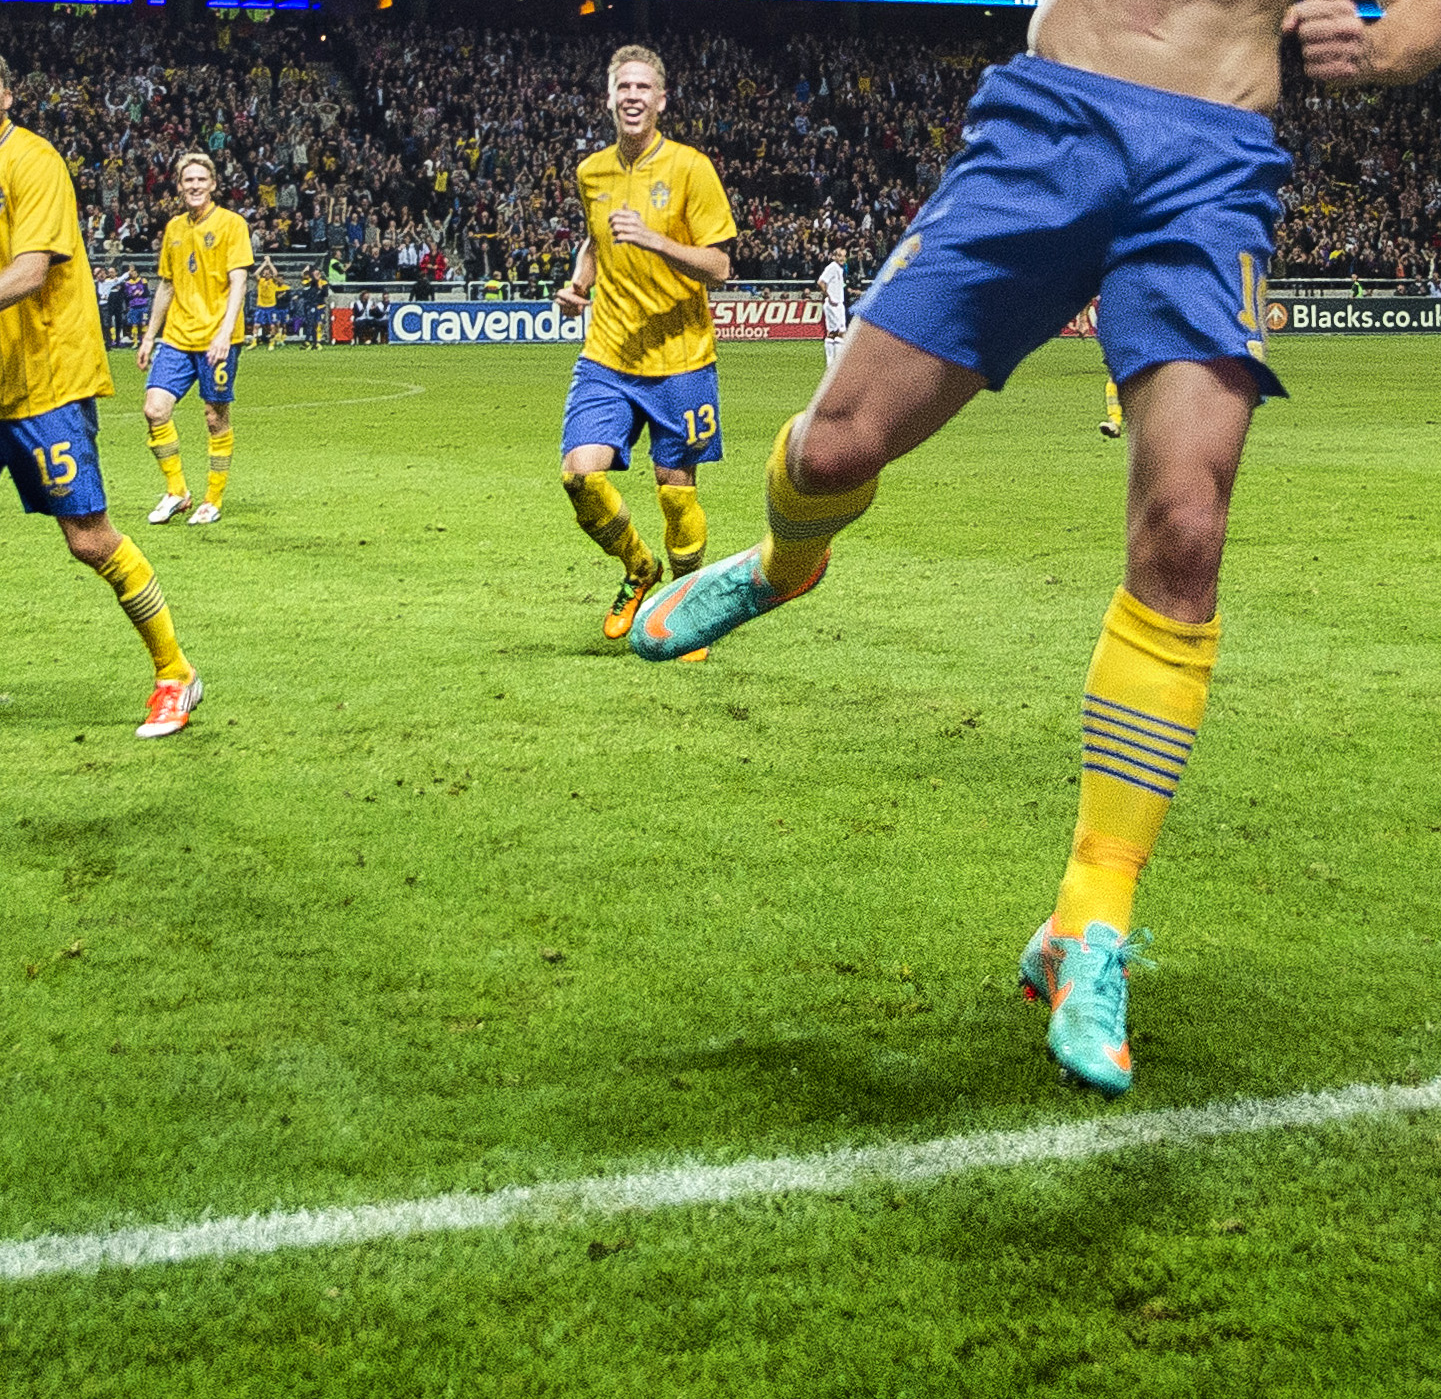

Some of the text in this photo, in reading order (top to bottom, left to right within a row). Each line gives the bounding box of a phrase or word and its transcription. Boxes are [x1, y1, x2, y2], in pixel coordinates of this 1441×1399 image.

[393, 302, 593, 341] Cravendal
[714, 324, 770, 338] outdoor
[214, 361, 229, 385] 6
[683, 403, 717, 446] 13
[32, 441, 78, 486] 15
